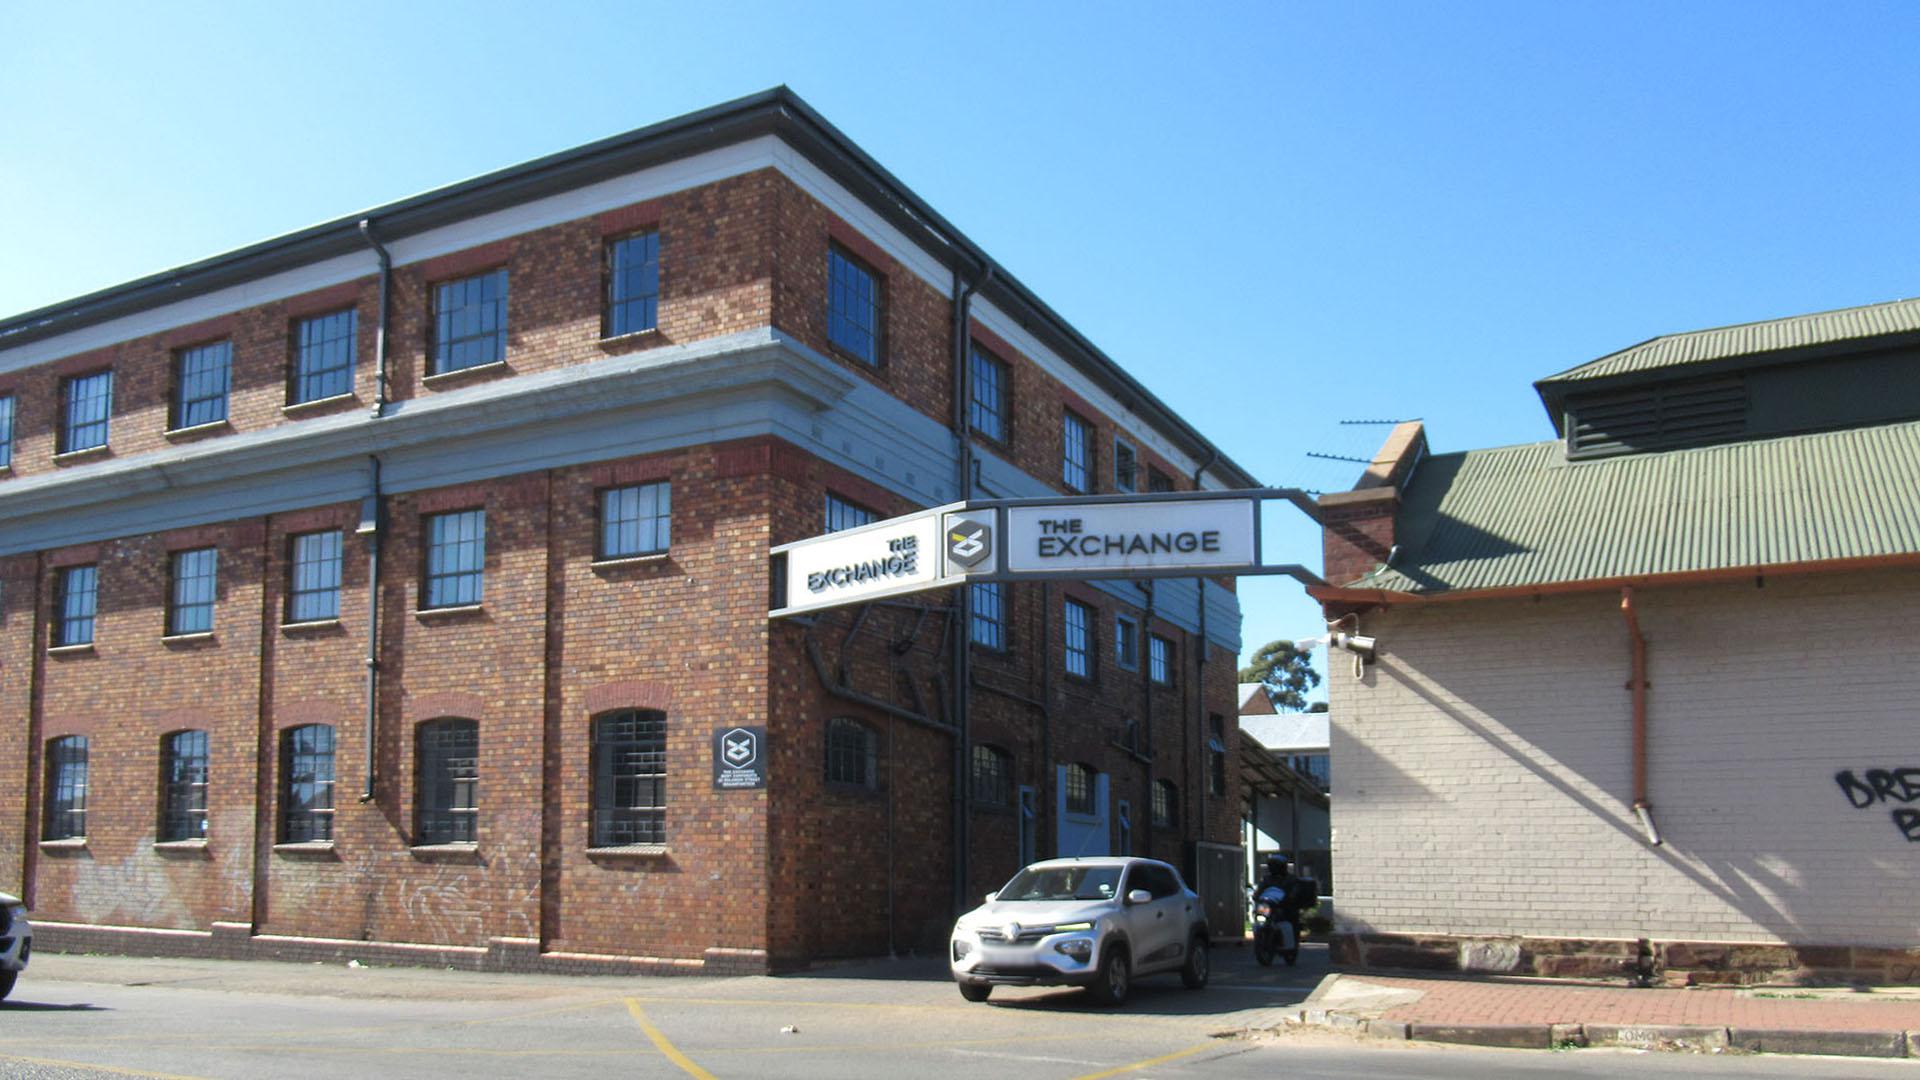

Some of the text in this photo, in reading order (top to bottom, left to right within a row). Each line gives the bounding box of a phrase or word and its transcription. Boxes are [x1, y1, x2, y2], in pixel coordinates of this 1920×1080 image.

[1038, 519, 1083, 534] THE
[886, 535, 917, 552] THE
[1038, 531, 1221, 557] EXCHANGE
[808, 552, 917, 591] EXCHANGE
